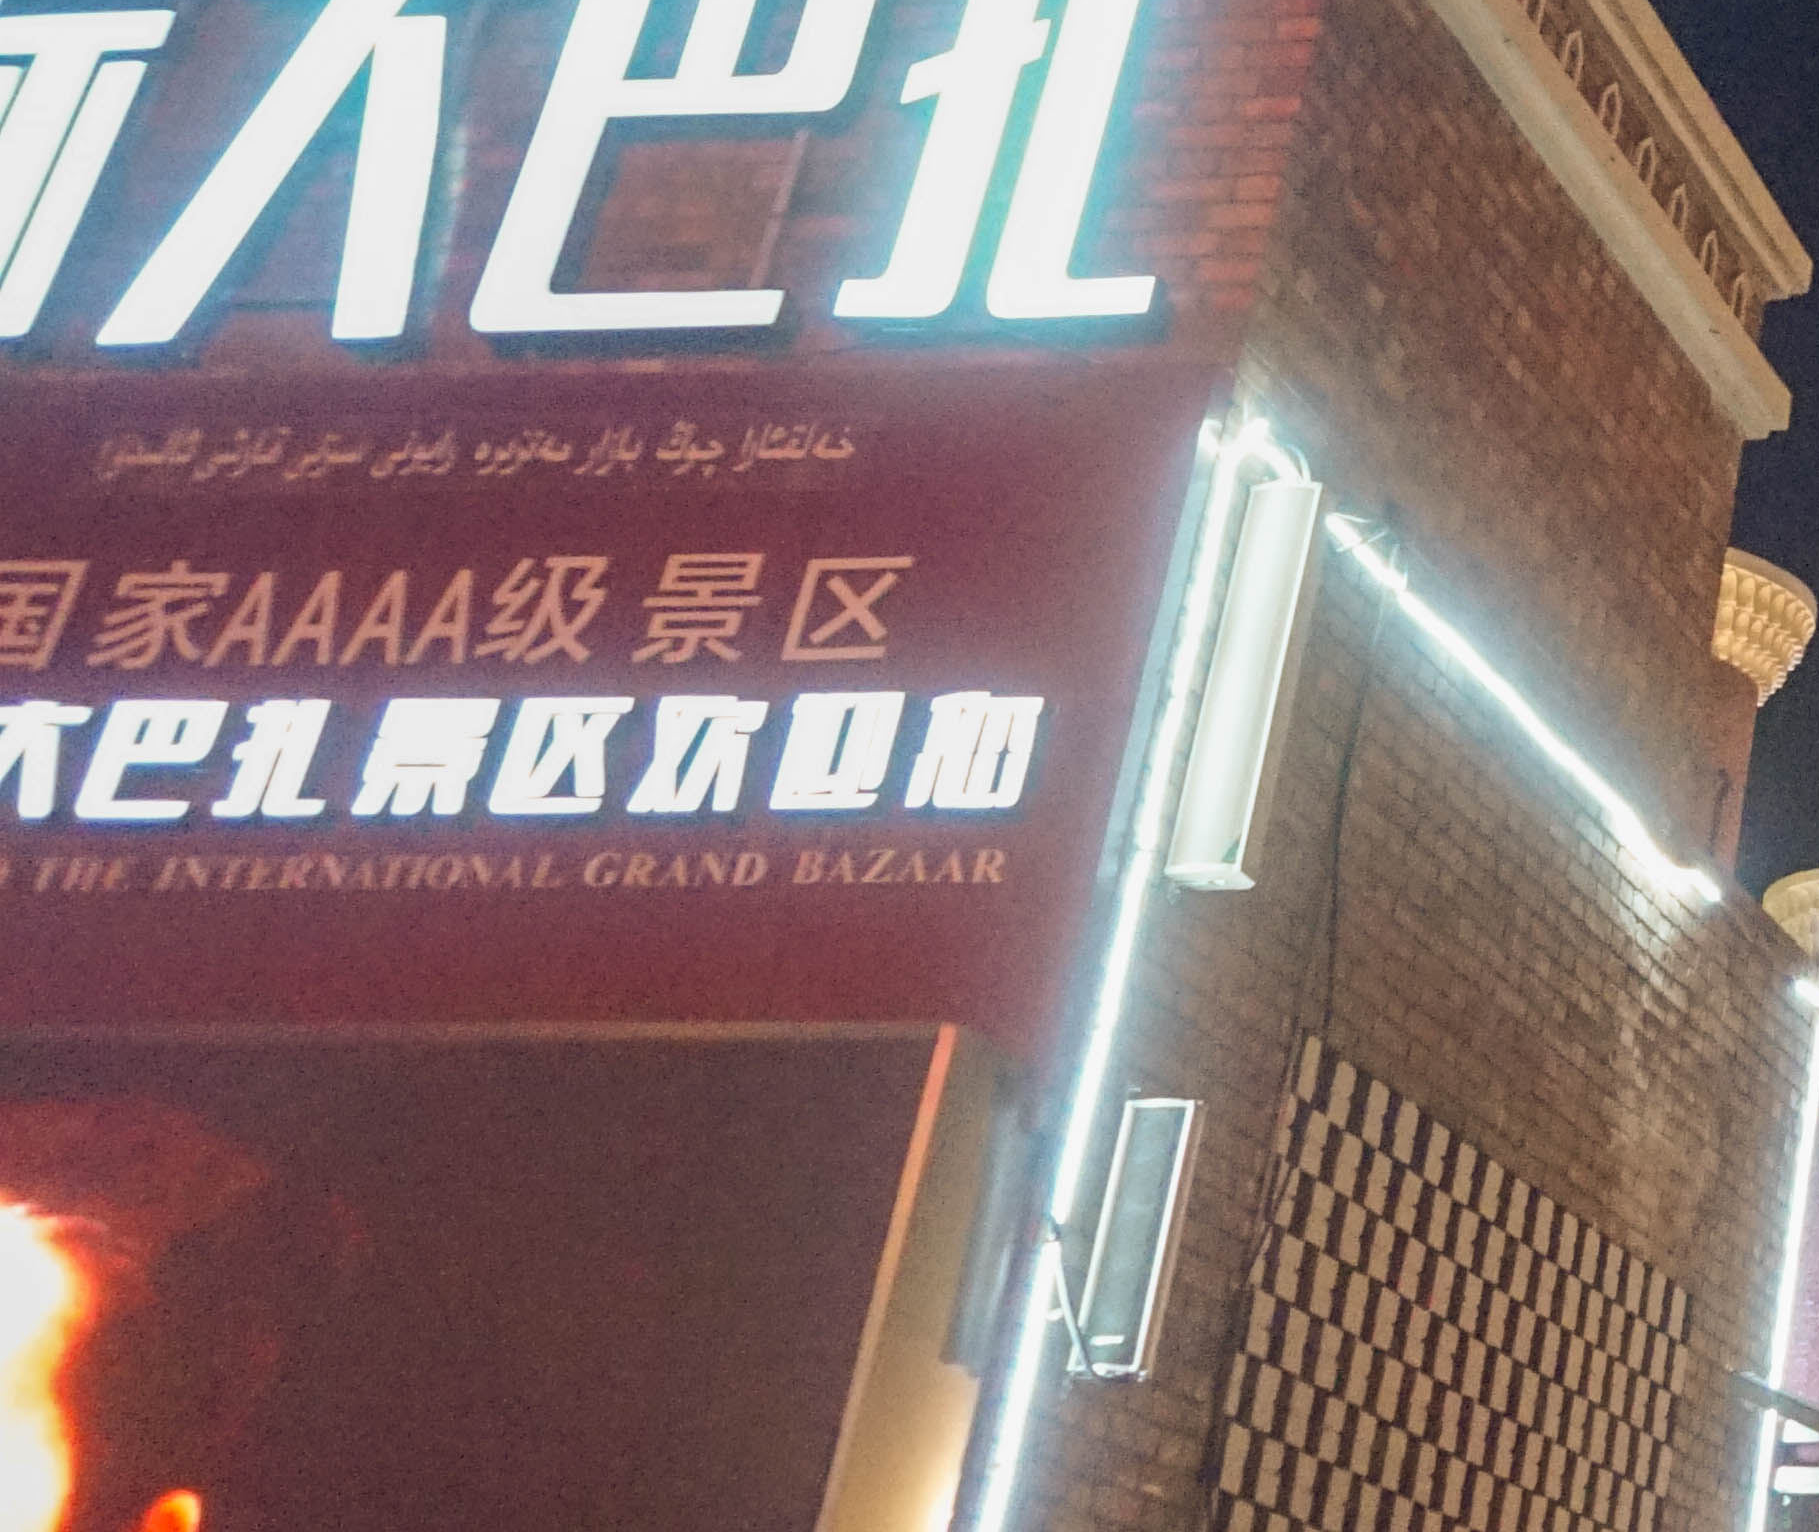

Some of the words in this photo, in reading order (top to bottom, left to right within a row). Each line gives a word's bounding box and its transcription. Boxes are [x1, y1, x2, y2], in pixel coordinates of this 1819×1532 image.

[33, 856, 130, 893] THE
[151, 853, 562, 892] INTERNATIONAL
[583, 851, 768, 888] GRAND
[792, 848, 1007, 885] BAZAAR
